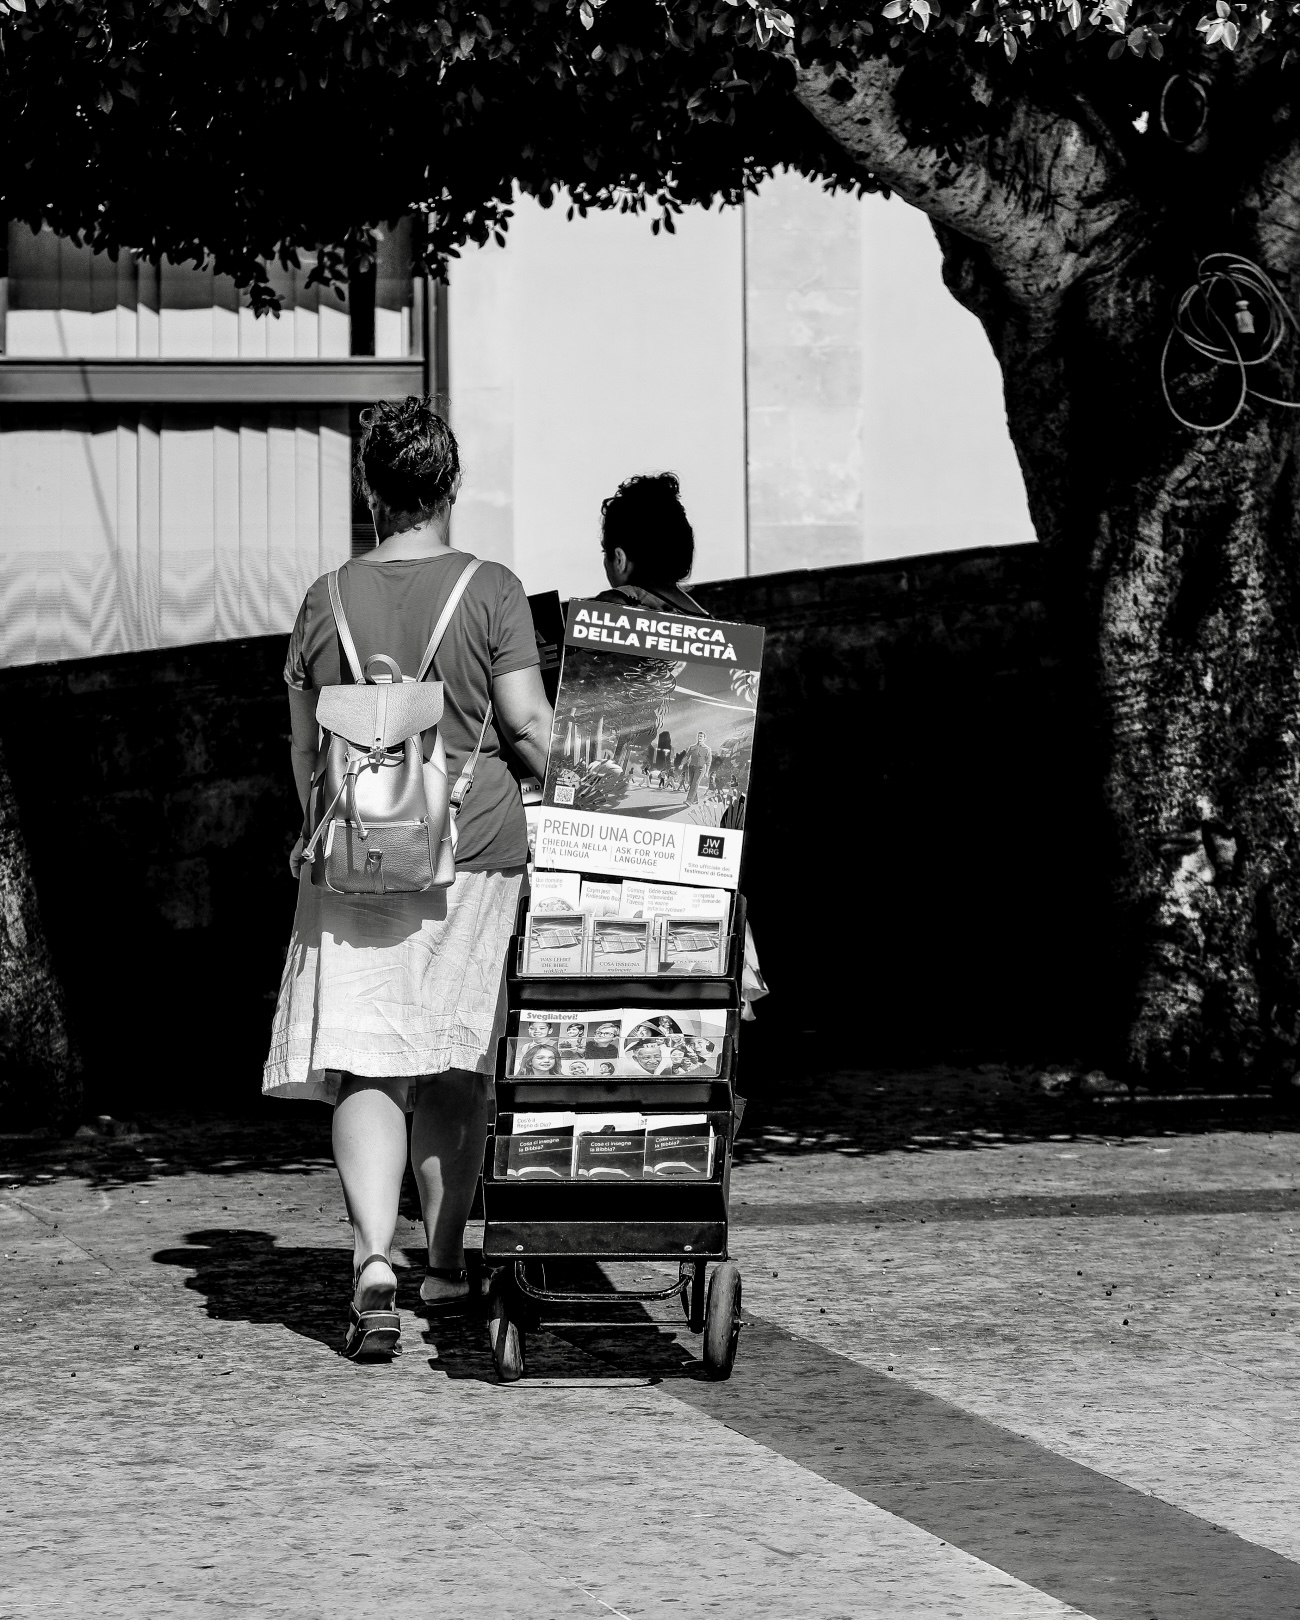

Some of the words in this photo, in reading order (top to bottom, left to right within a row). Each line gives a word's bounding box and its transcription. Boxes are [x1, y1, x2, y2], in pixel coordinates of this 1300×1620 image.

[575, 609, 630, 629] ALLA
[636, 617, 725, 643] RICERCA
[573, 624, 640, 647] DELLA
[645, 635, 737, 661] FELICITÀ
[543, 819, 594, 838] PRENDI
[600, 826, 628, 842] UNA
[633, 830, 675, 848] COPIA
[542, 838, 579, 849] CHIEDILA
[582, 842, 607, 852] NELLA
[704, 838, 720, 848] JW
[560, 848, 589, 859] LINGUA
[616, 846, 631, 855] ASK
[634, 849, 650, 857] FOR
[654, 851, 675, 860] YOUR
[614, 855, 658, 866] LANGUAGE
[527, 1012, 578, 1020] Svegliatevi!
[661, 1140, 679, 1148] Bibbia?
